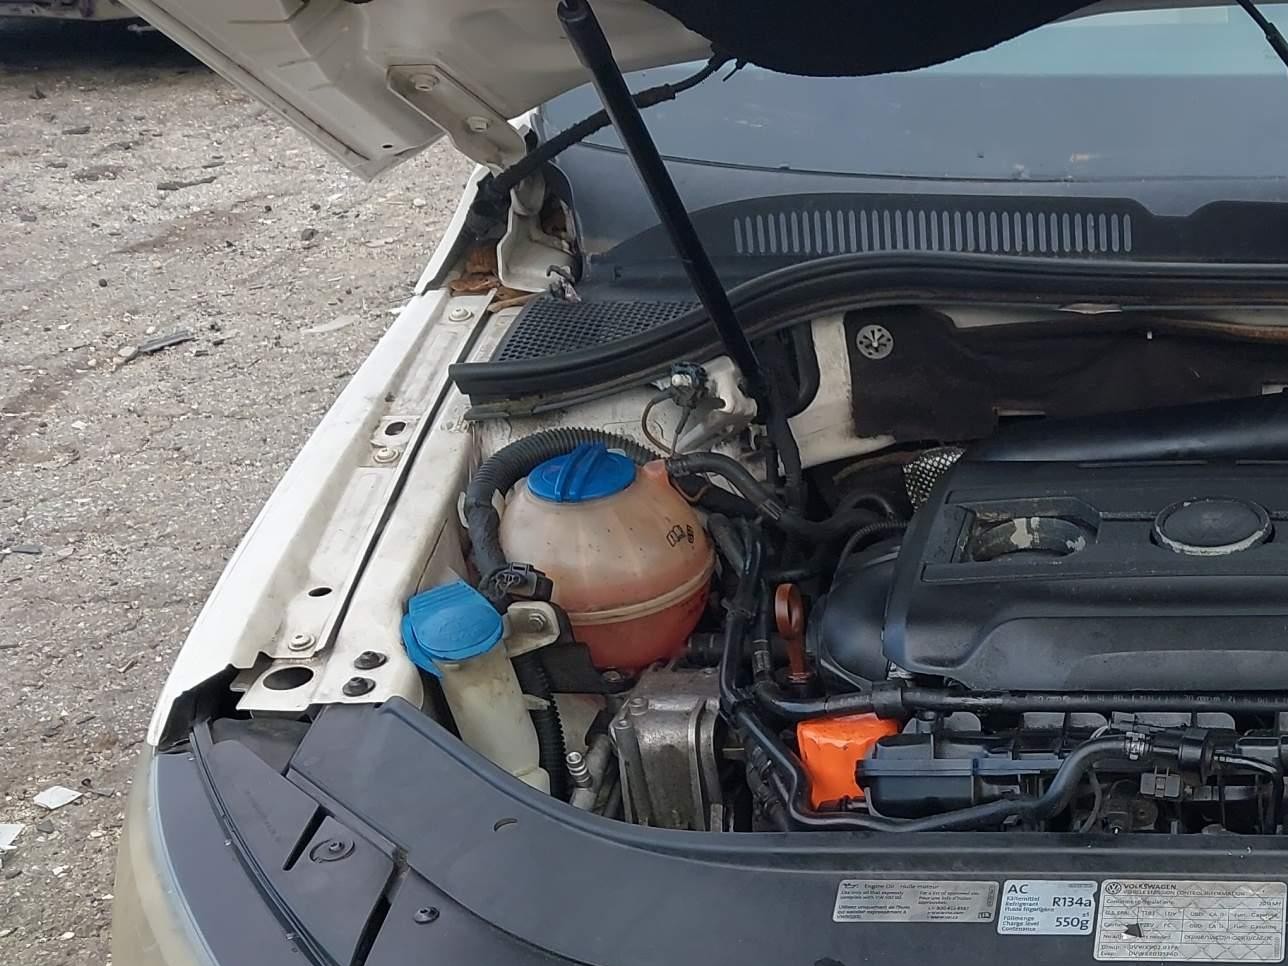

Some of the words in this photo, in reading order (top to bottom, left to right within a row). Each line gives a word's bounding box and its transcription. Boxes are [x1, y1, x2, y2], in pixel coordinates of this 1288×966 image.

[1007, 883, 1029, 894] AC
[1052, 896, 1092, 907] R134a
[1055, 916, 1090, 931] 550g
